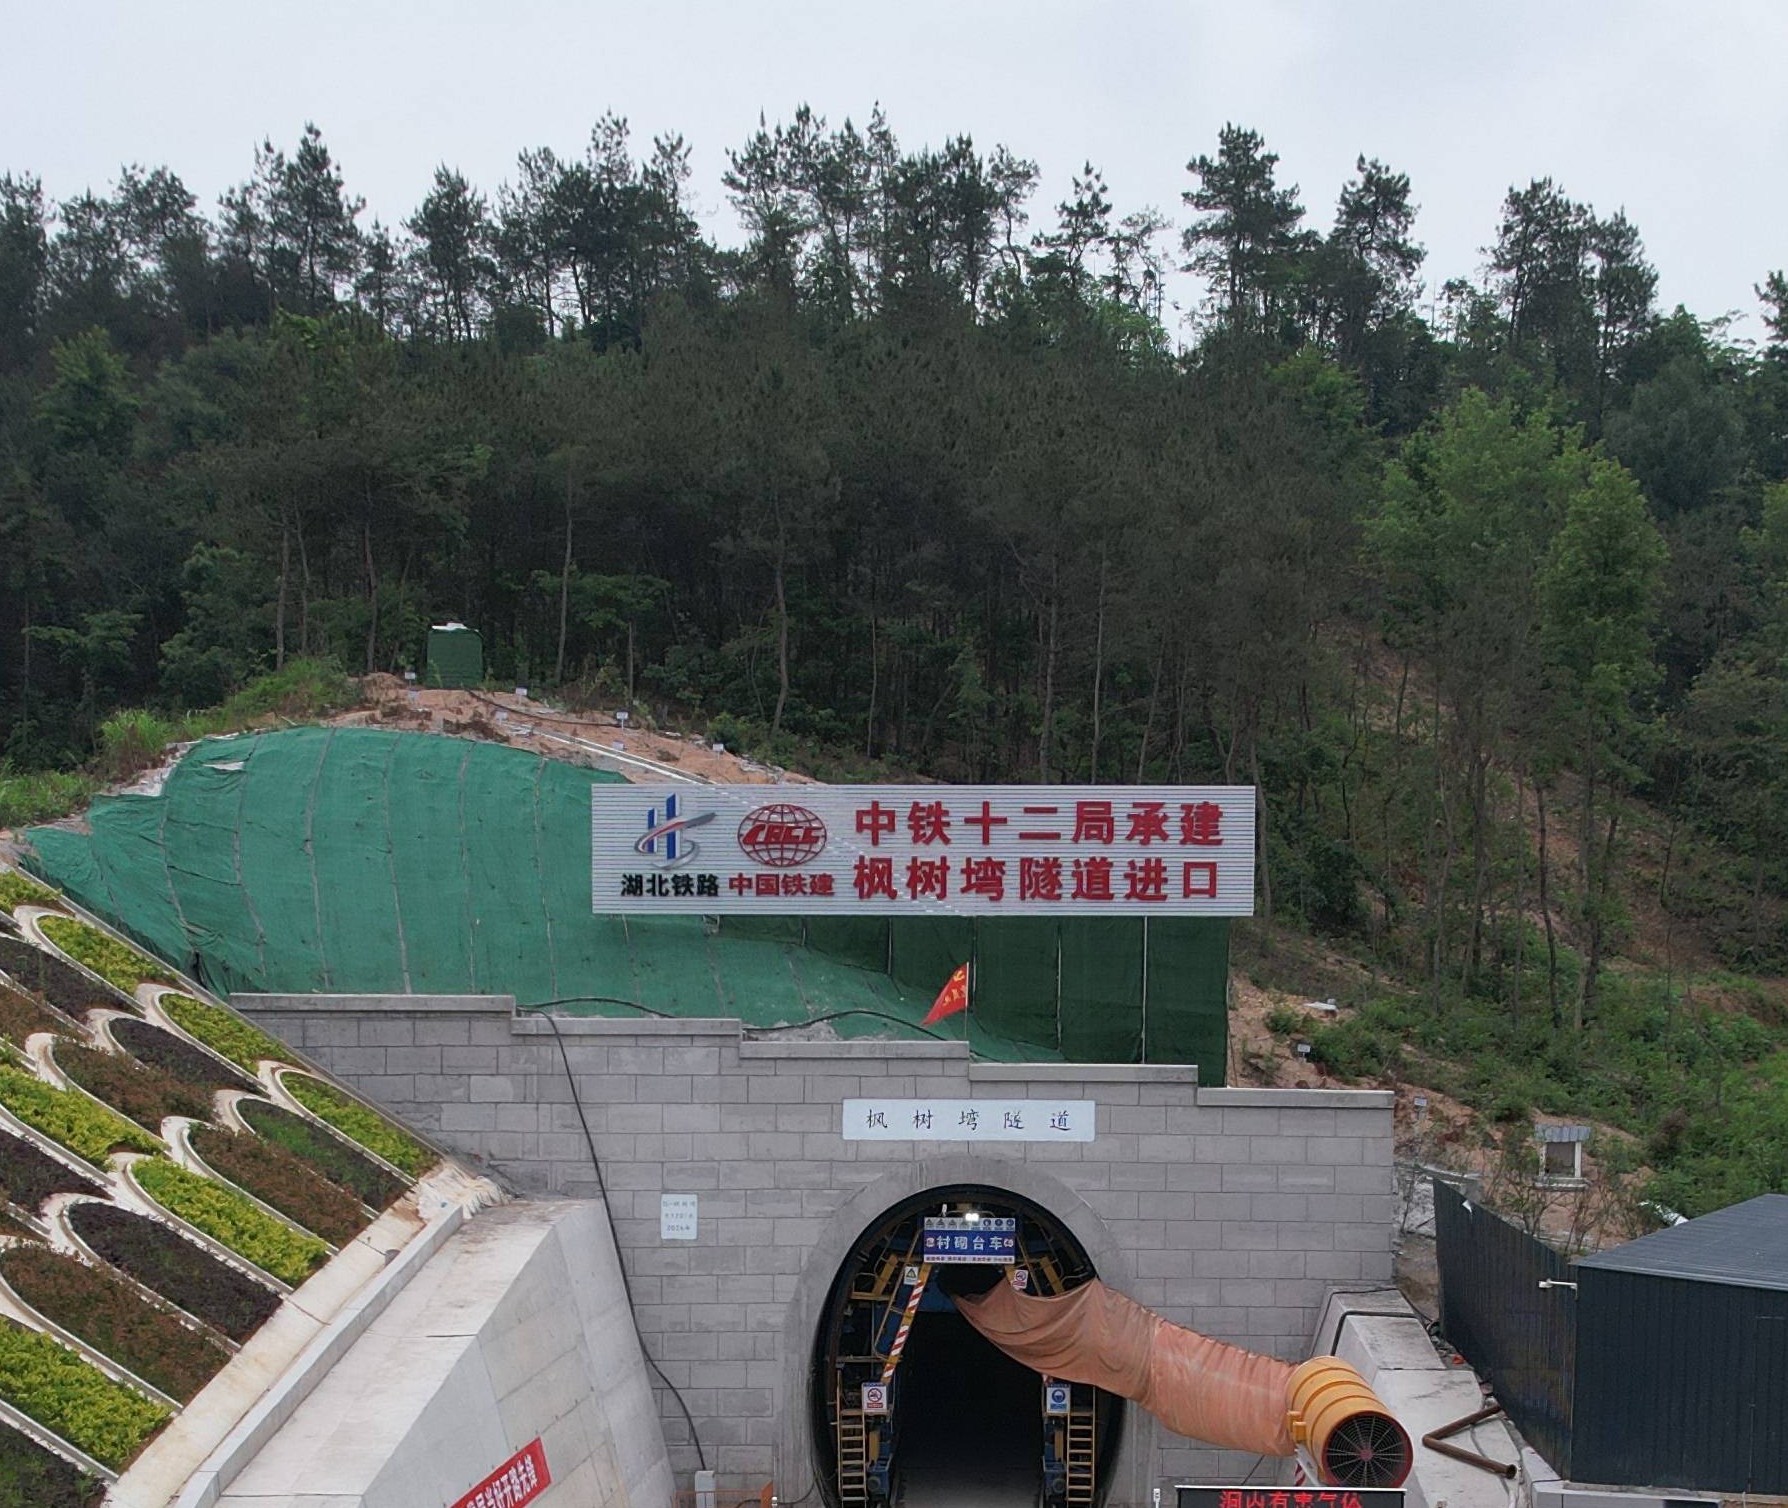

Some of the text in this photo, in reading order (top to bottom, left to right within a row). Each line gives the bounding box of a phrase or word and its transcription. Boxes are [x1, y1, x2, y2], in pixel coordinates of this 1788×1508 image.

[743, 823, 822, 845] CRCC
[855, 800, 1223, 846] 中铁十二局承建
[620, 873, 720, 897] 湖北铁路
[728, 872, 836, 897] 中国铁建
[853, 855, 1219, 902] 枫树湾隧道进口
[866, 1108, 1071, 1132] 枫树湾隧道
